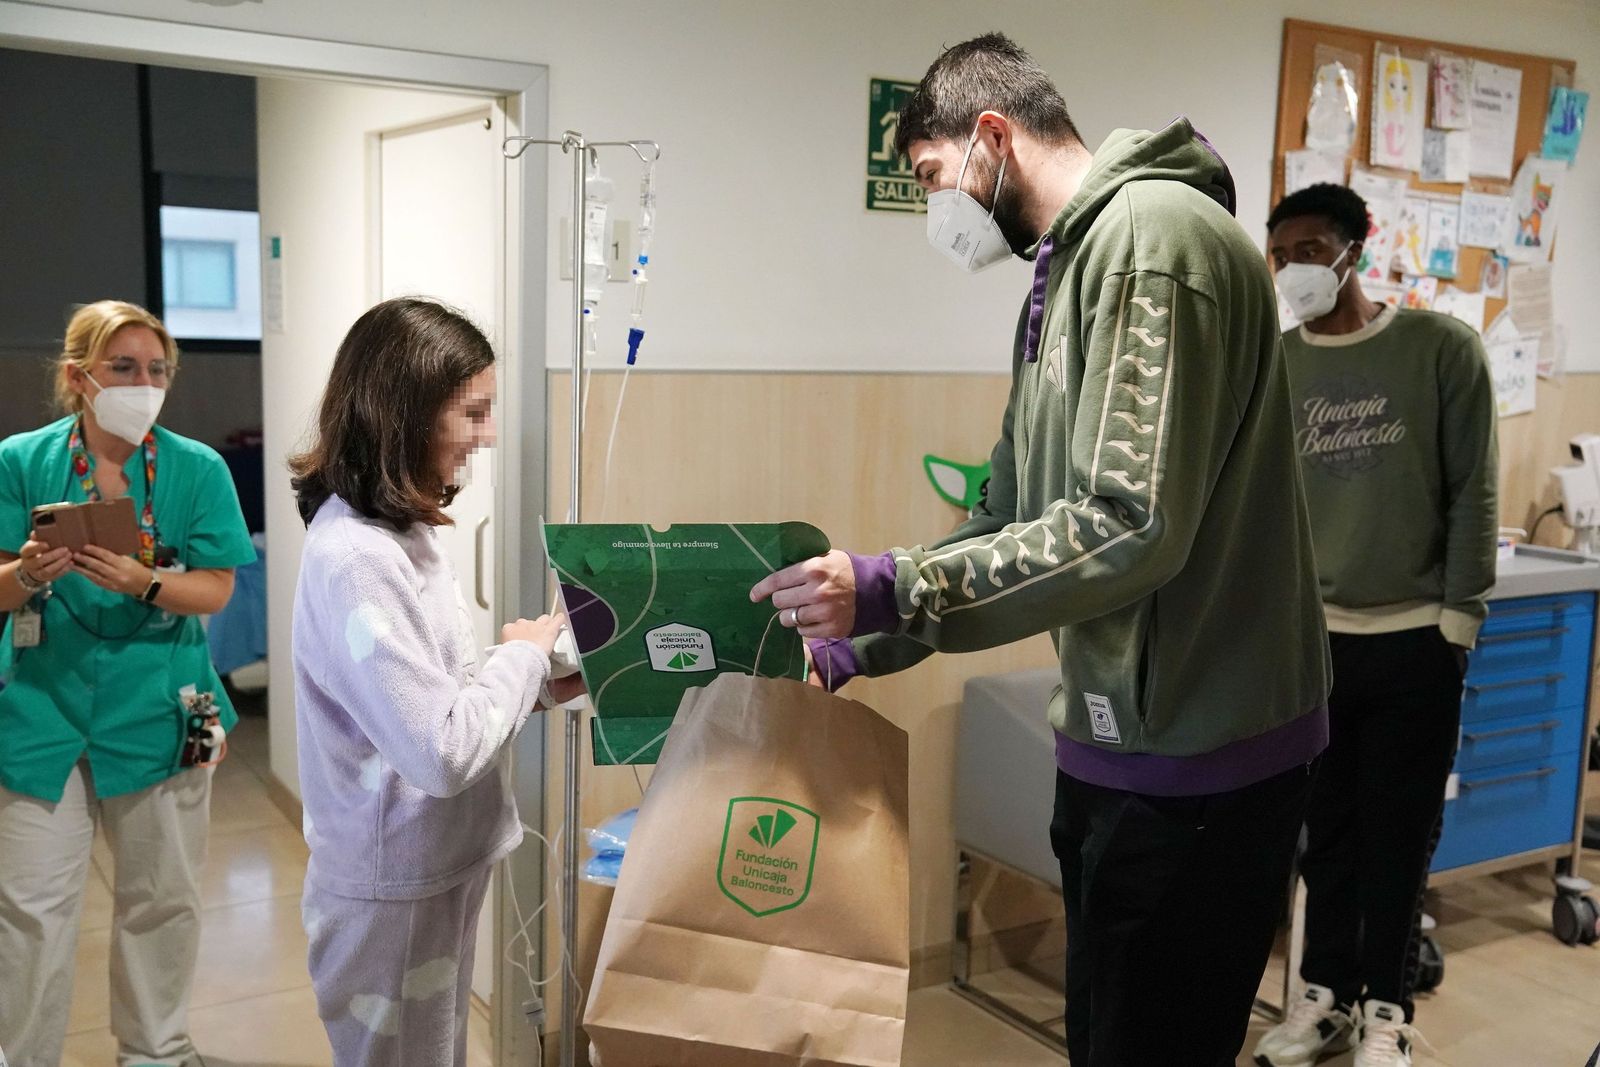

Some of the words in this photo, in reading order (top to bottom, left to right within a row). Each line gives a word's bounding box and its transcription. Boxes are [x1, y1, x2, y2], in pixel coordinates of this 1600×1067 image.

[1303, 393, 1388, 429] Unicaja
[1296, 417, 1406, 456] Baloncesto
[612, 540, 649, 549] conmigo
[651, 541, 672, 550] llevo
[682, 540, 719, 549] Siempre
[735, 849, 798, 871] Fundación
[742, 865, 788, 884] Unicaja
[730, 875, 795, 896] Baloncesto
